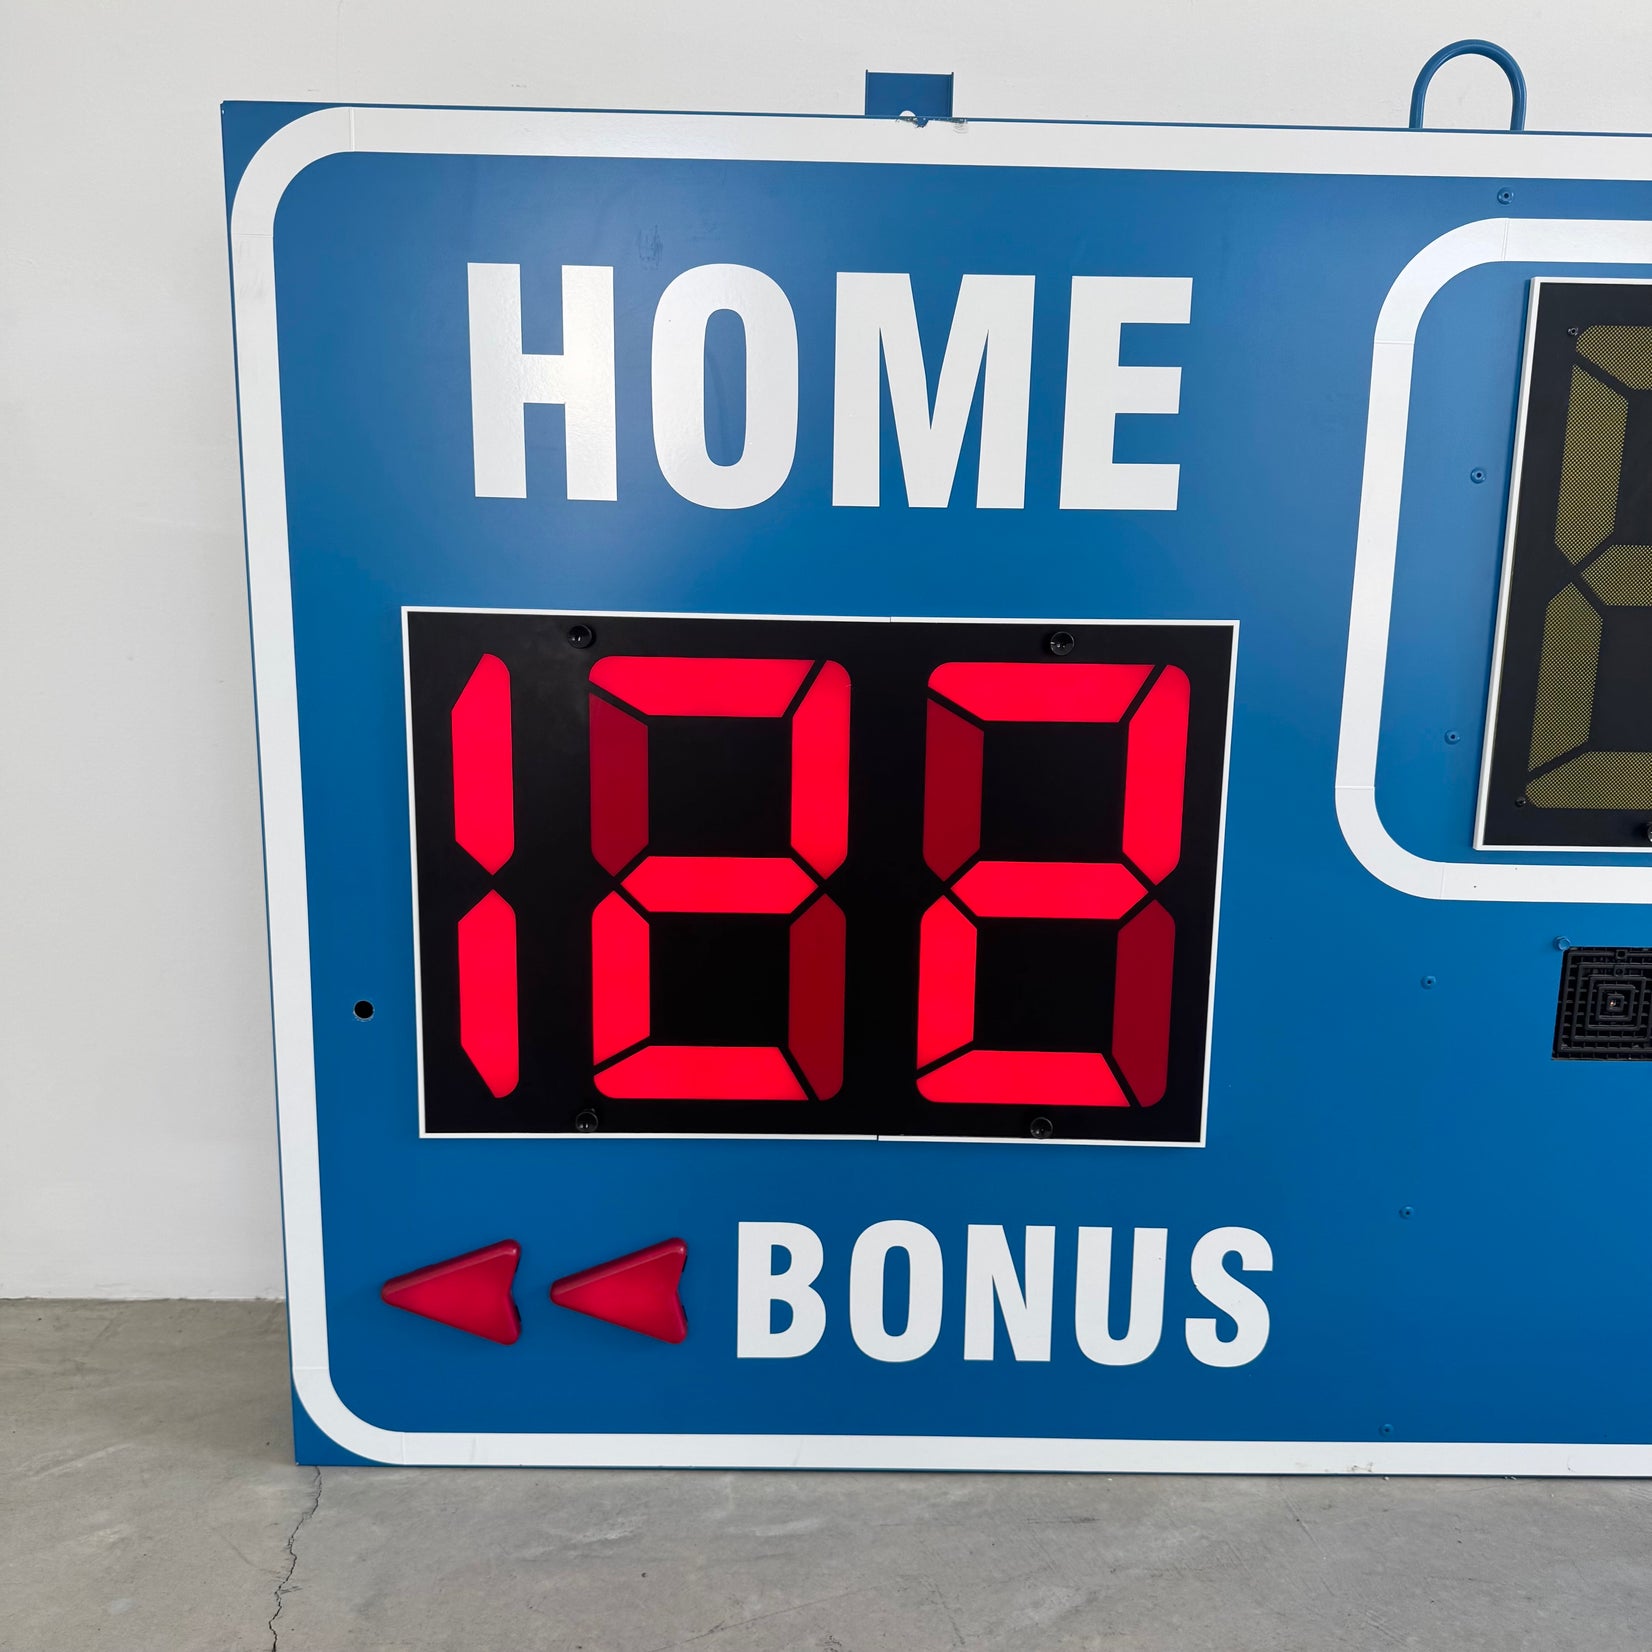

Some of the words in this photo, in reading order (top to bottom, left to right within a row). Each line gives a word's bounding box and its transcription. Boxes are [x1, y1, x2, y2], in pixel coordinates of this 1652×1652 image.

[467, 262, 1193, 511] HOME
[451, 654, 1190, 1106] 122
[736, 1220, 1274, 1368] BONUS
